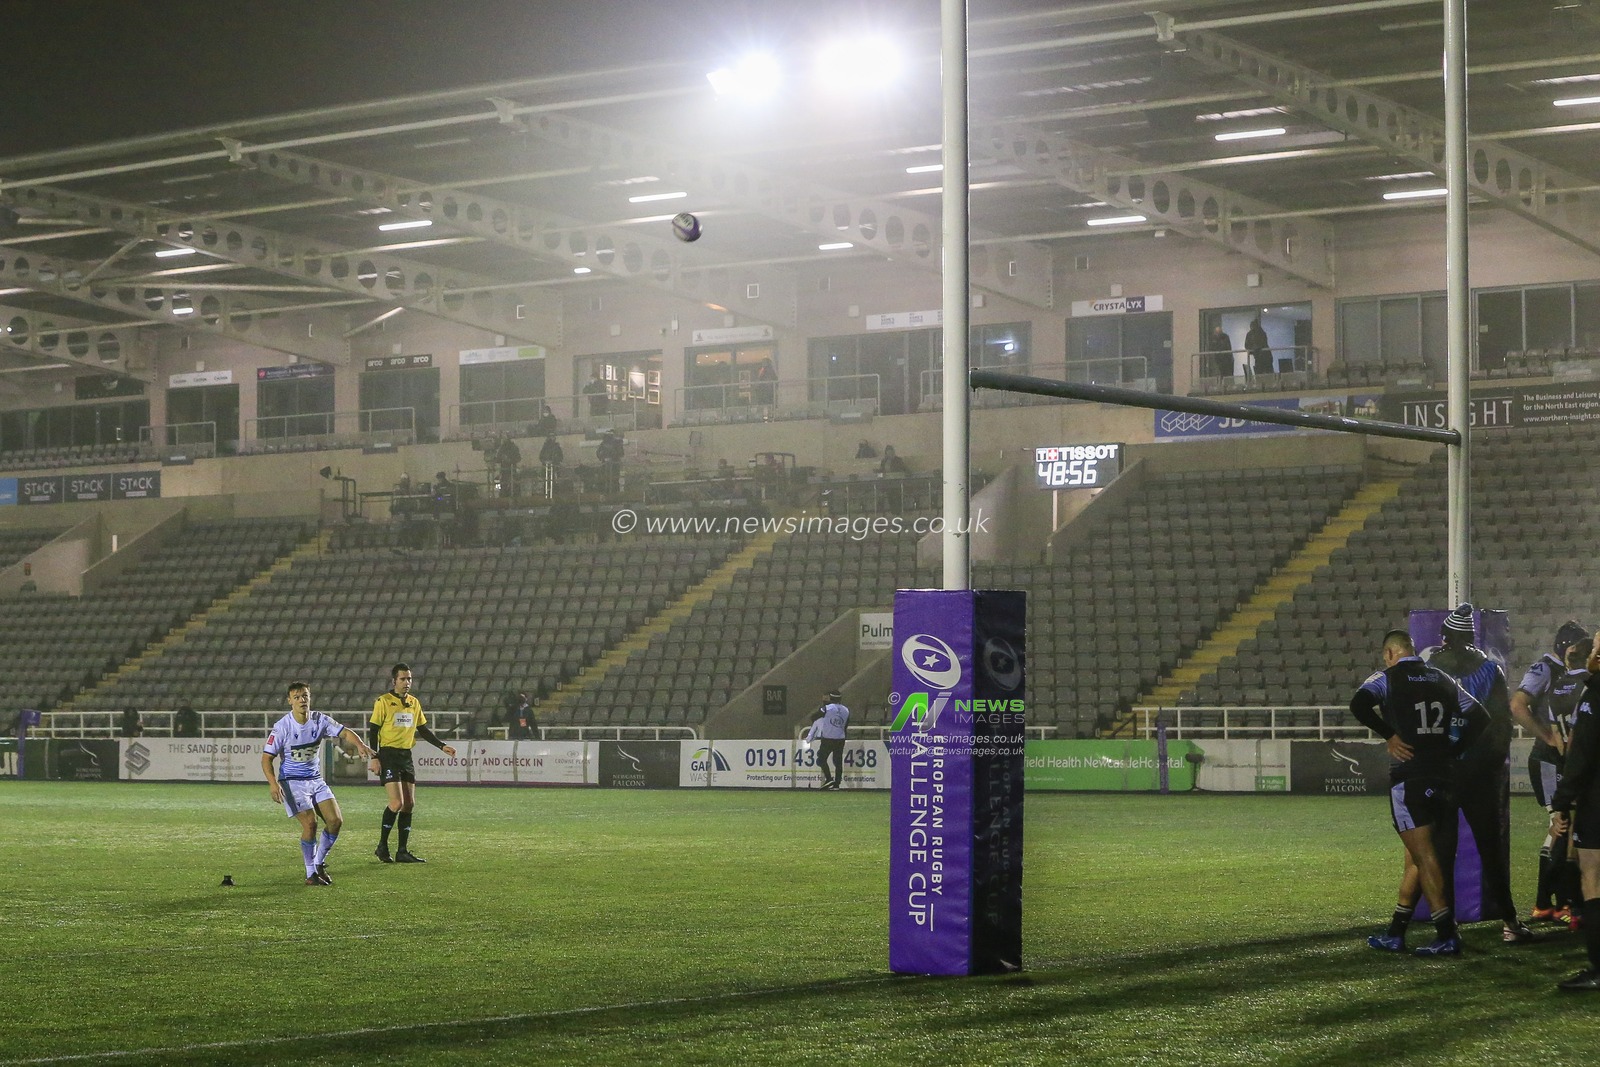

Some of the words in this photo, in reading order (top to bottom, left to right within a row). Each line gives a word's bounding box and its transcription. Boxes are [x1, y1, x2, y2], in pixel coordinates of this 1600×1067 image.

[1093, 299, 1143, 312] CRYSTALYX
[1523, 394, 1535, 402] The
[1535, 393, 1562, 401] Business
[1563, 392, 1575, 400] and
[1575, 391, 1597, 399] Leisure
[1523, 403, 1532, 411] for
[1533, 403, 1544, 411] the
[1545, 402, 1564, 410] North
[1564, 401, 1578, 409] East
[1403, 400, 1513, 428] INSGHT
[1058, 444, 1118, 461] TISSOT
[1037, 460, 1098, 486] 48:56
[766, 689, 783, 701] BAR
[1414, 701, 1444, 735] 12
[1450, 717, 1465, 727] 20
[168, 743, 187, 753] THE
[187, 744, 218, 754] SANDS
[220, 744, 251, 754] GROUP
[418, 757, 445, 767] CHECK
[447, 757, 458, 767] US
[460, 758, 479, 767] OUT
[482, 757, 501, 767] AND
[502, 757, 531, 767] CHECK
[533, 758, 543, 767] IN
[745, 748, 786, 767] 0191
[1047, 756, 1081, 768] Health
[690, 760, 712, 772] GAP
[746, 774, 774, 782] Protecting
[909, 702, 930, 864] CHALLENGE
[931, 734, 945, 828] EUROPEAN
[931, 836, 944, 896] RUGBY
[908, 872, 927, 926] CUP
